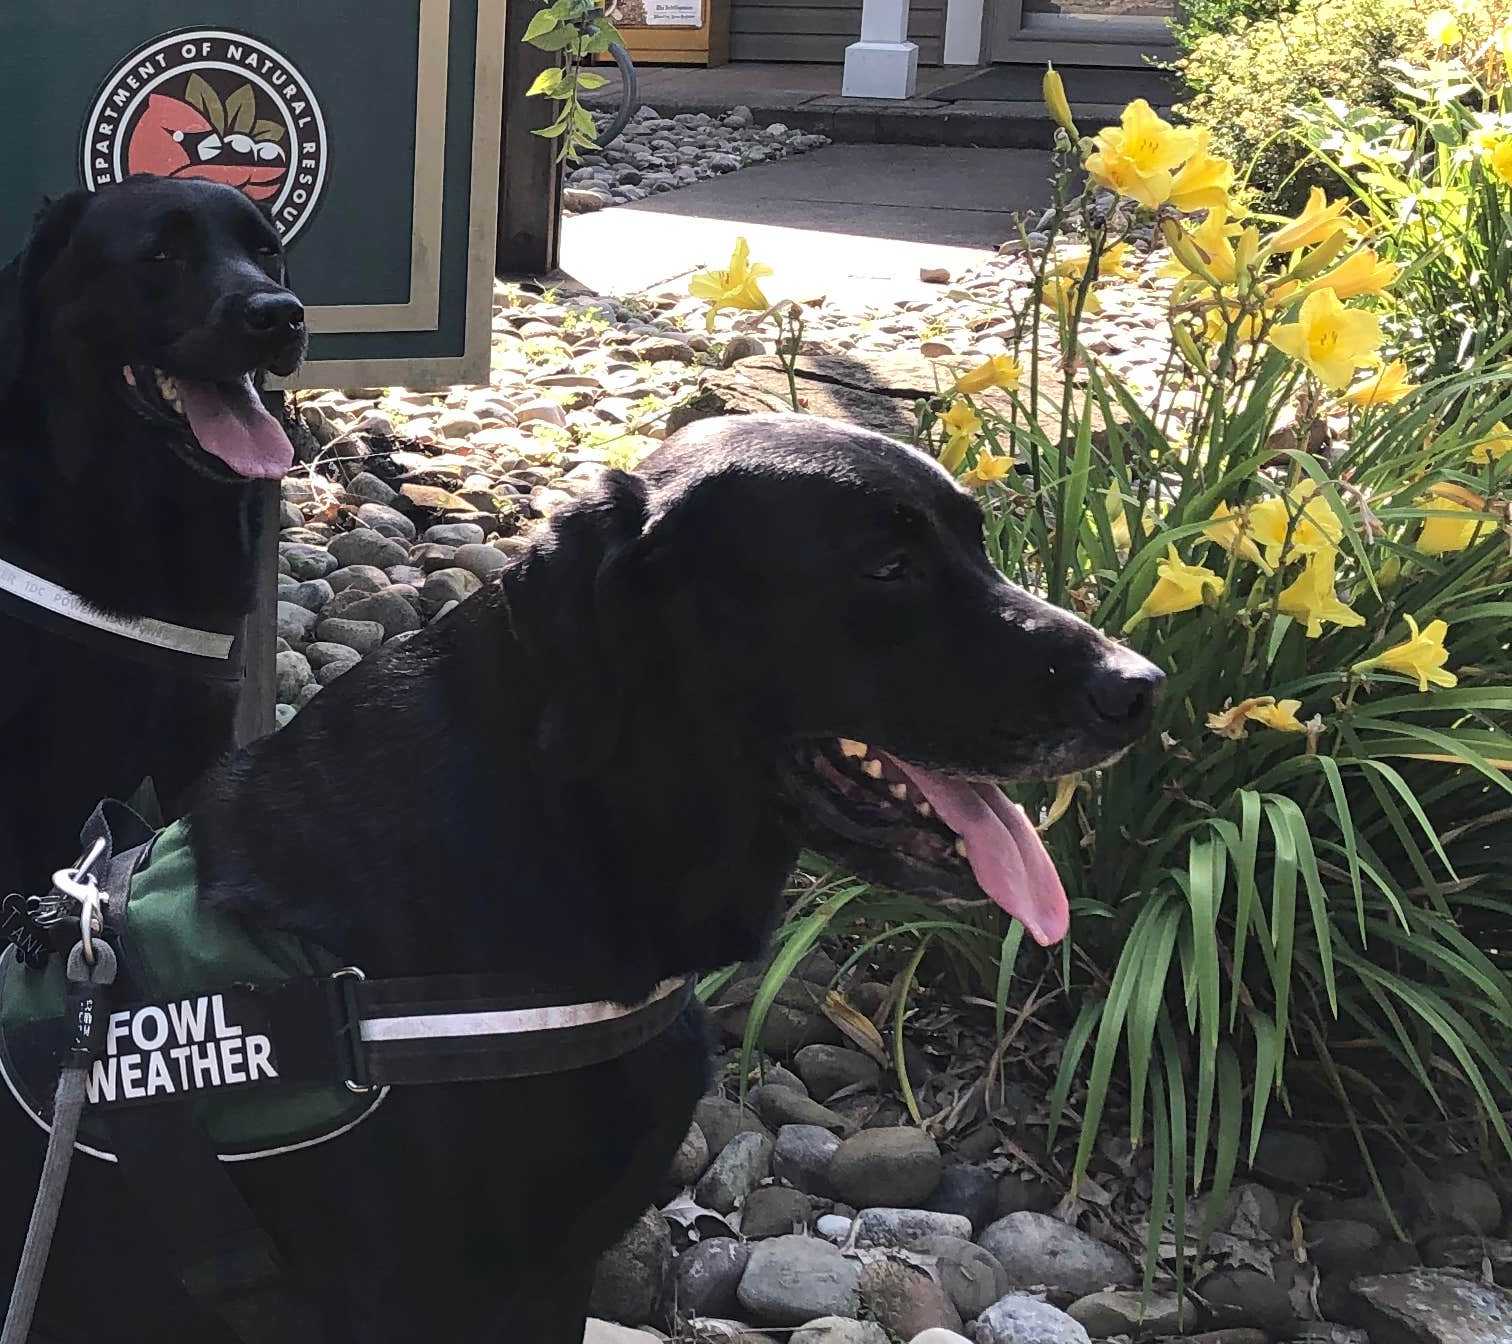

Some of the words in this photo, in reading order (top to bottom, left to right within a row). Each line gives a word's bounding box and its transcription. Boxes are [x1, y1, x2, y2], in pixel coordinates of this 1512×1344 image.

[96, 53, 167, 184] EPARTMENT
[181, 42, 212, 59] OF
[227, 44, 313, 128] NATURAL
[107, 994, 243, 1056] FOWL
[86, 1034, 280, 1104] WEATHER
